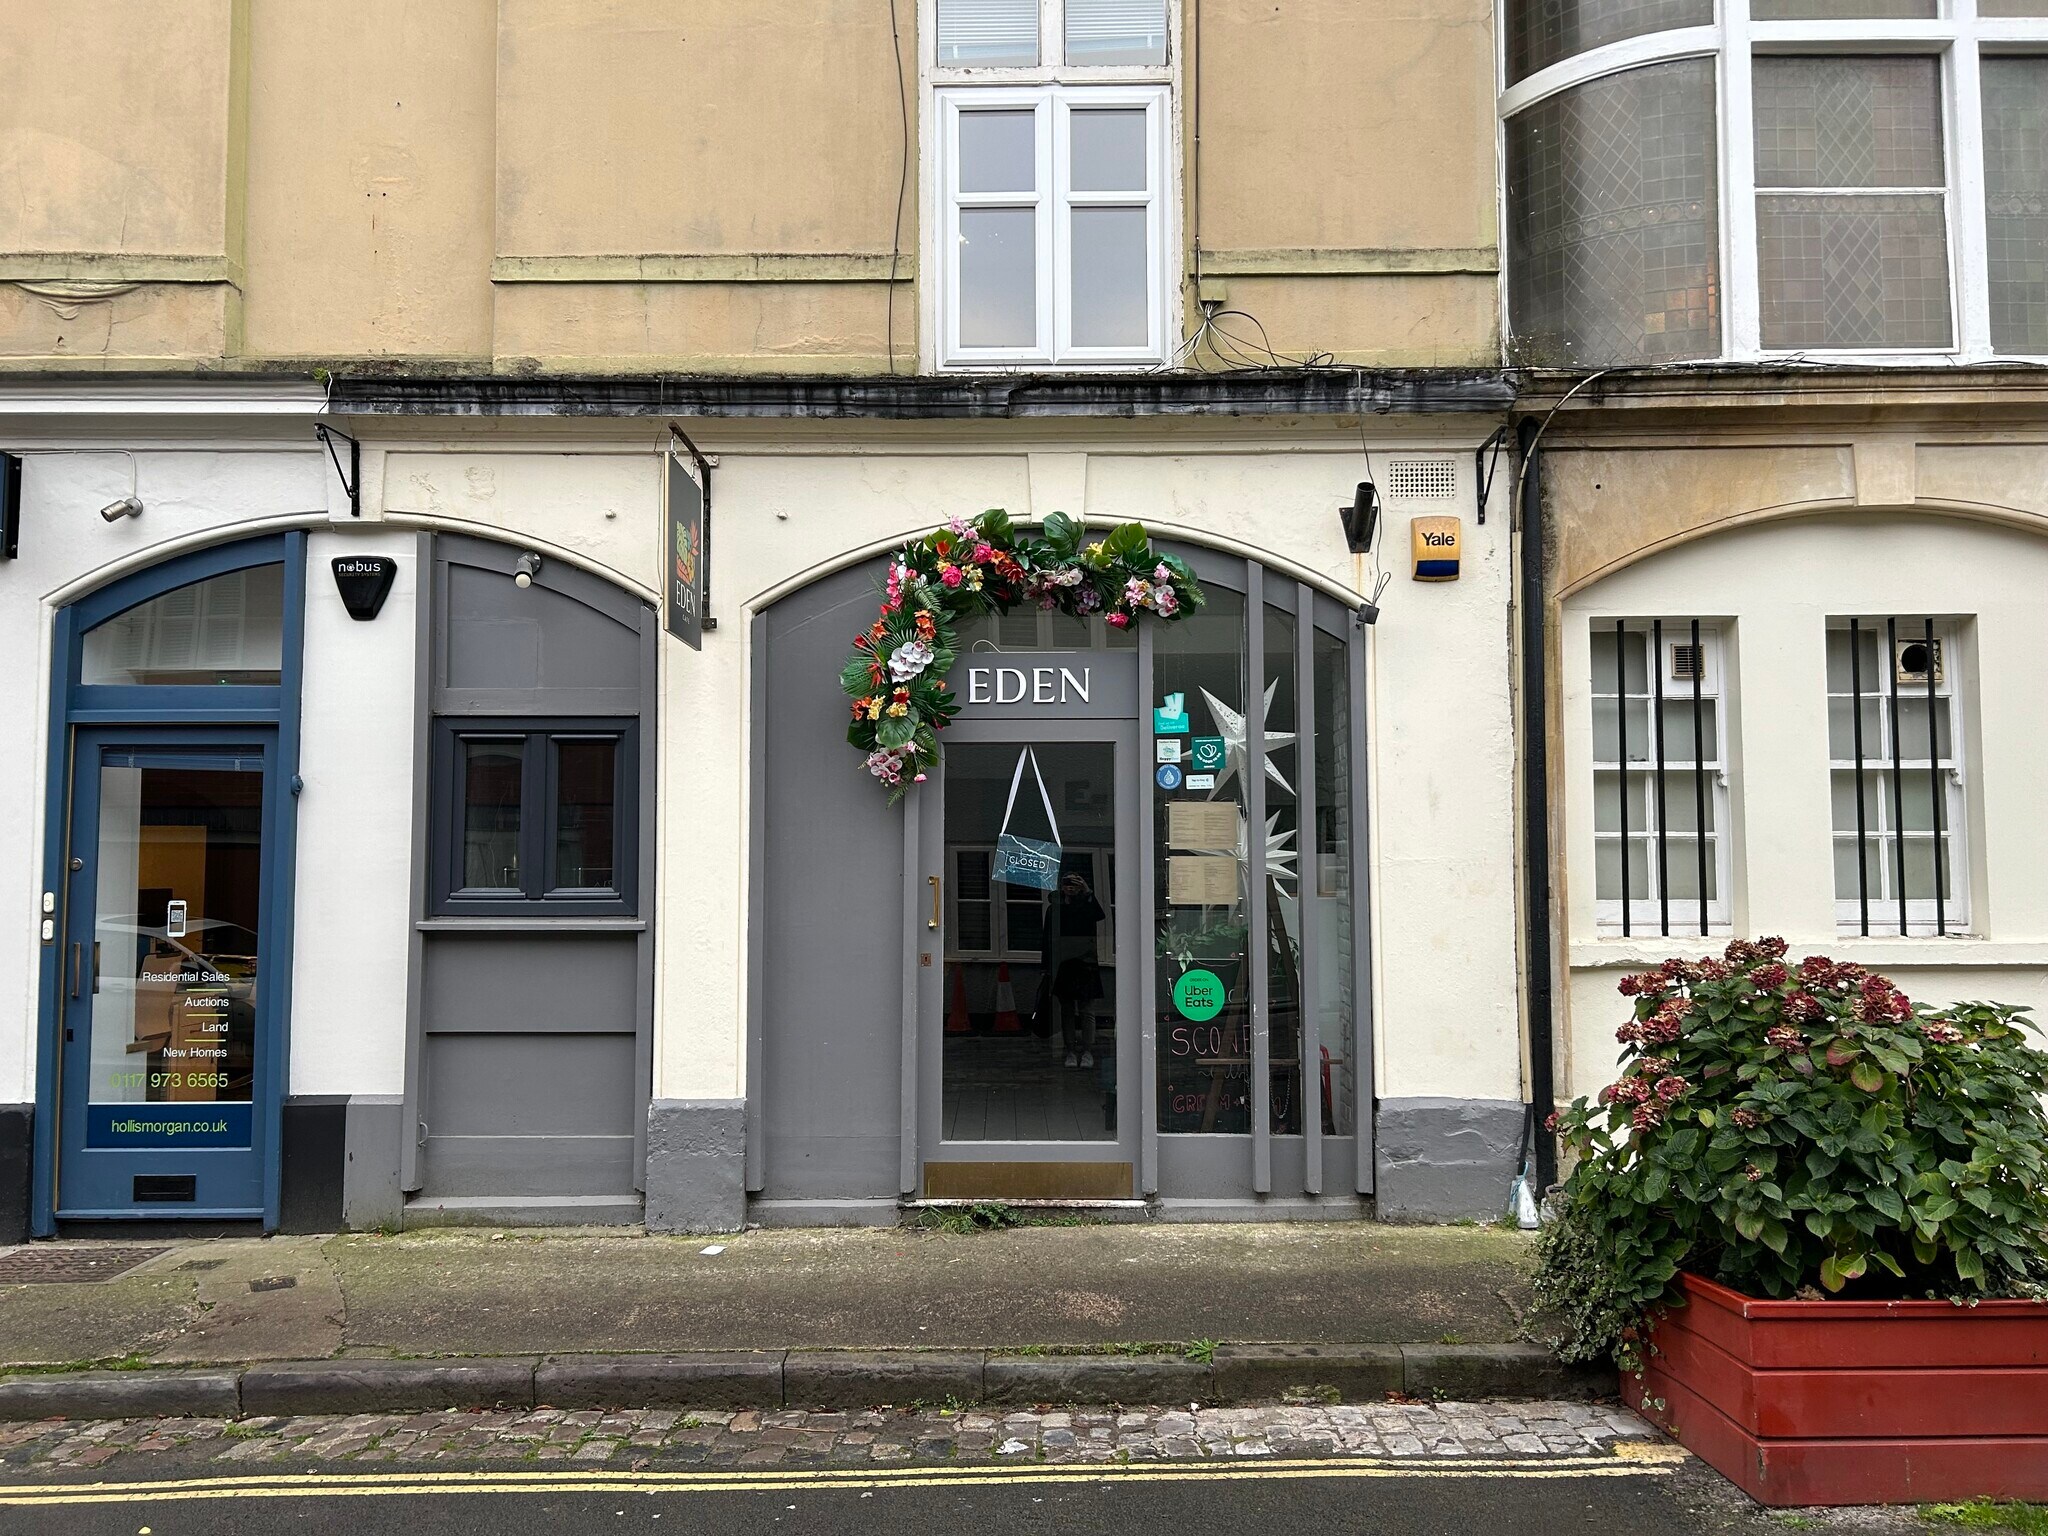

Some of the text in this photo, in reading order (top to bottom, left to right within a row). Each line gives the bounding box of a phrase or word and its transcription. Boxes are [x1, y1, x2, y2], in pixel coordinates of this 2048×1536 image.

[1421, 532, 1456, 547] Yale
[338, 560, 381, 572] nobus
[676, 579, 696, 618] EDEN
[968, 667, 1090, 704] EDEN
[1009, 855, 1046, 869] CLOSED
[142, 971, 230, 982] Residential Sales
[1184, 985, 1213, 996] Uber
[184, 996, 229, 1007] Auctions
[1185, 997, 1214, 1008] Eats
[202, 1021, 229, 1032] Land
[163, 1047, 228, 1058] New Homes
[111, 1072, 228, 1088] 0117 973 6565
[111, 1119, 228, 1136] hollismorgan.co.uk
